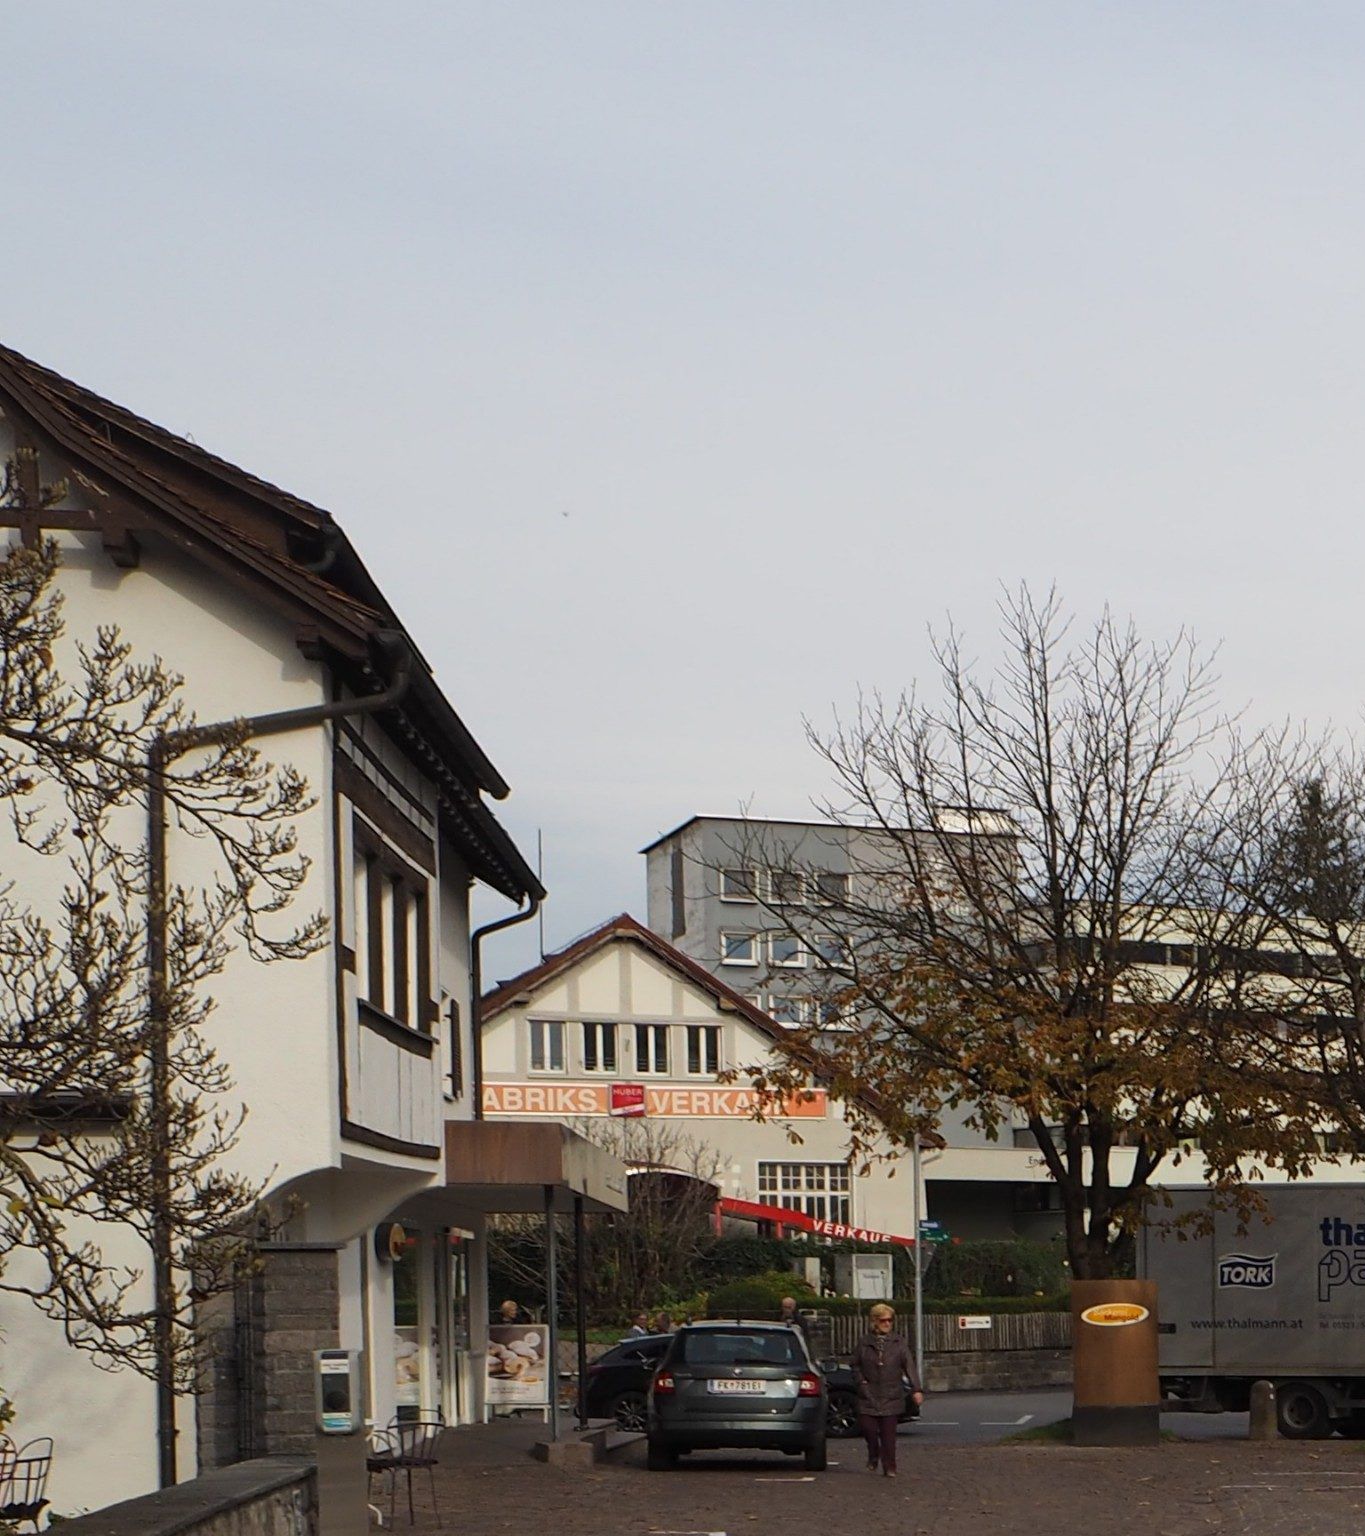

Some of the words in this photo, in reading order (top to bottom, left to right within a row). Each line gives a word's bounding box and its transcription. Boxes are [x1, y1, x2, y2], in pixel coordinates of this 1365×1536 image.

[482, 1087, 597, 1112] ABRIKS
[813, 1219, 892, 1244] VERKAUF
[1221, 1266, 1270, 1284] TORK
[1190, 1318, 1304, 1330] www.thalmann.at
